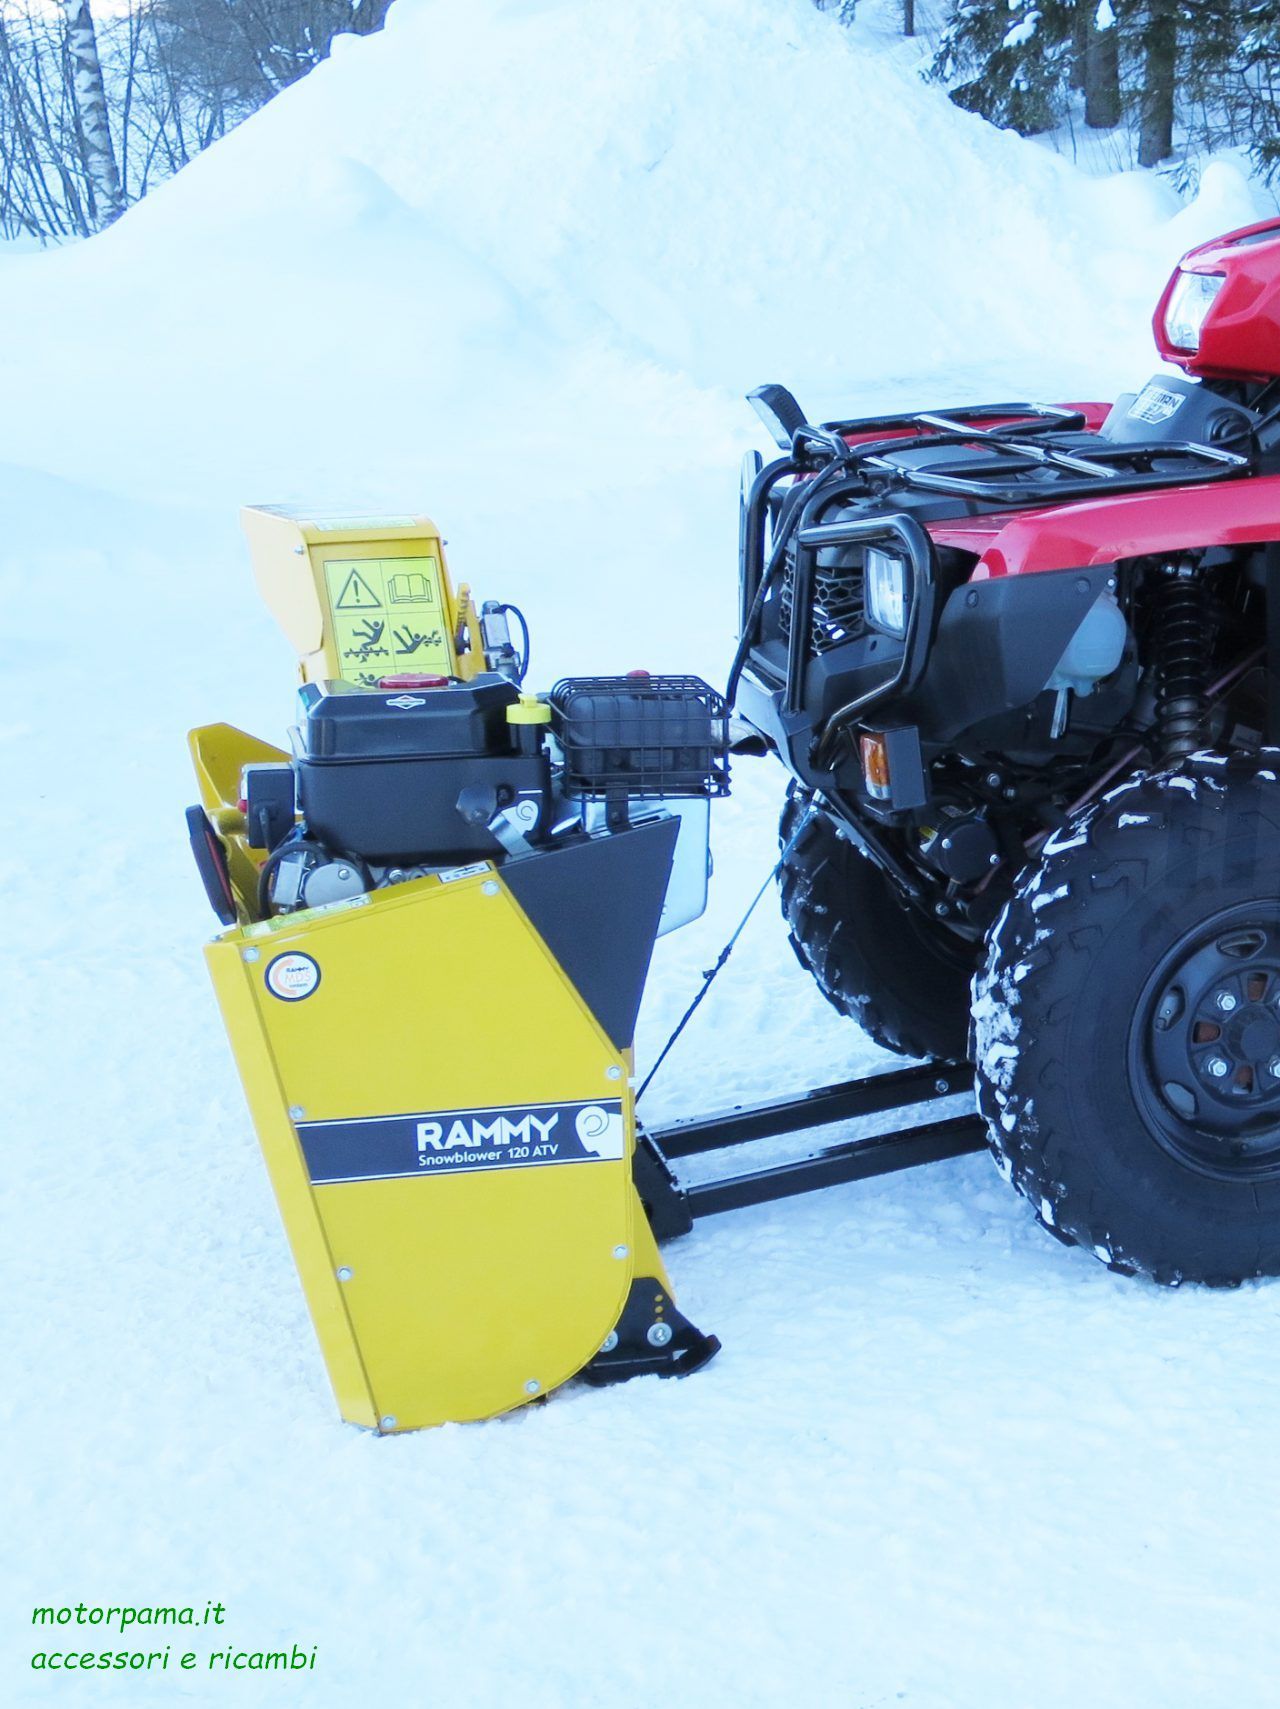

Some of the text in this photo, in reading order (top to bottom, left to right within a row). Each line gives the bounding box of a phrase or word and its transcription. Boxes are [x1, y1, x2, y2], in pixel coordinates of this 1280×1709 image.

[416, 1111, 559, 1151] RAMMY
[419, 1144, 559, 1167] Snowblower 120 ATV
